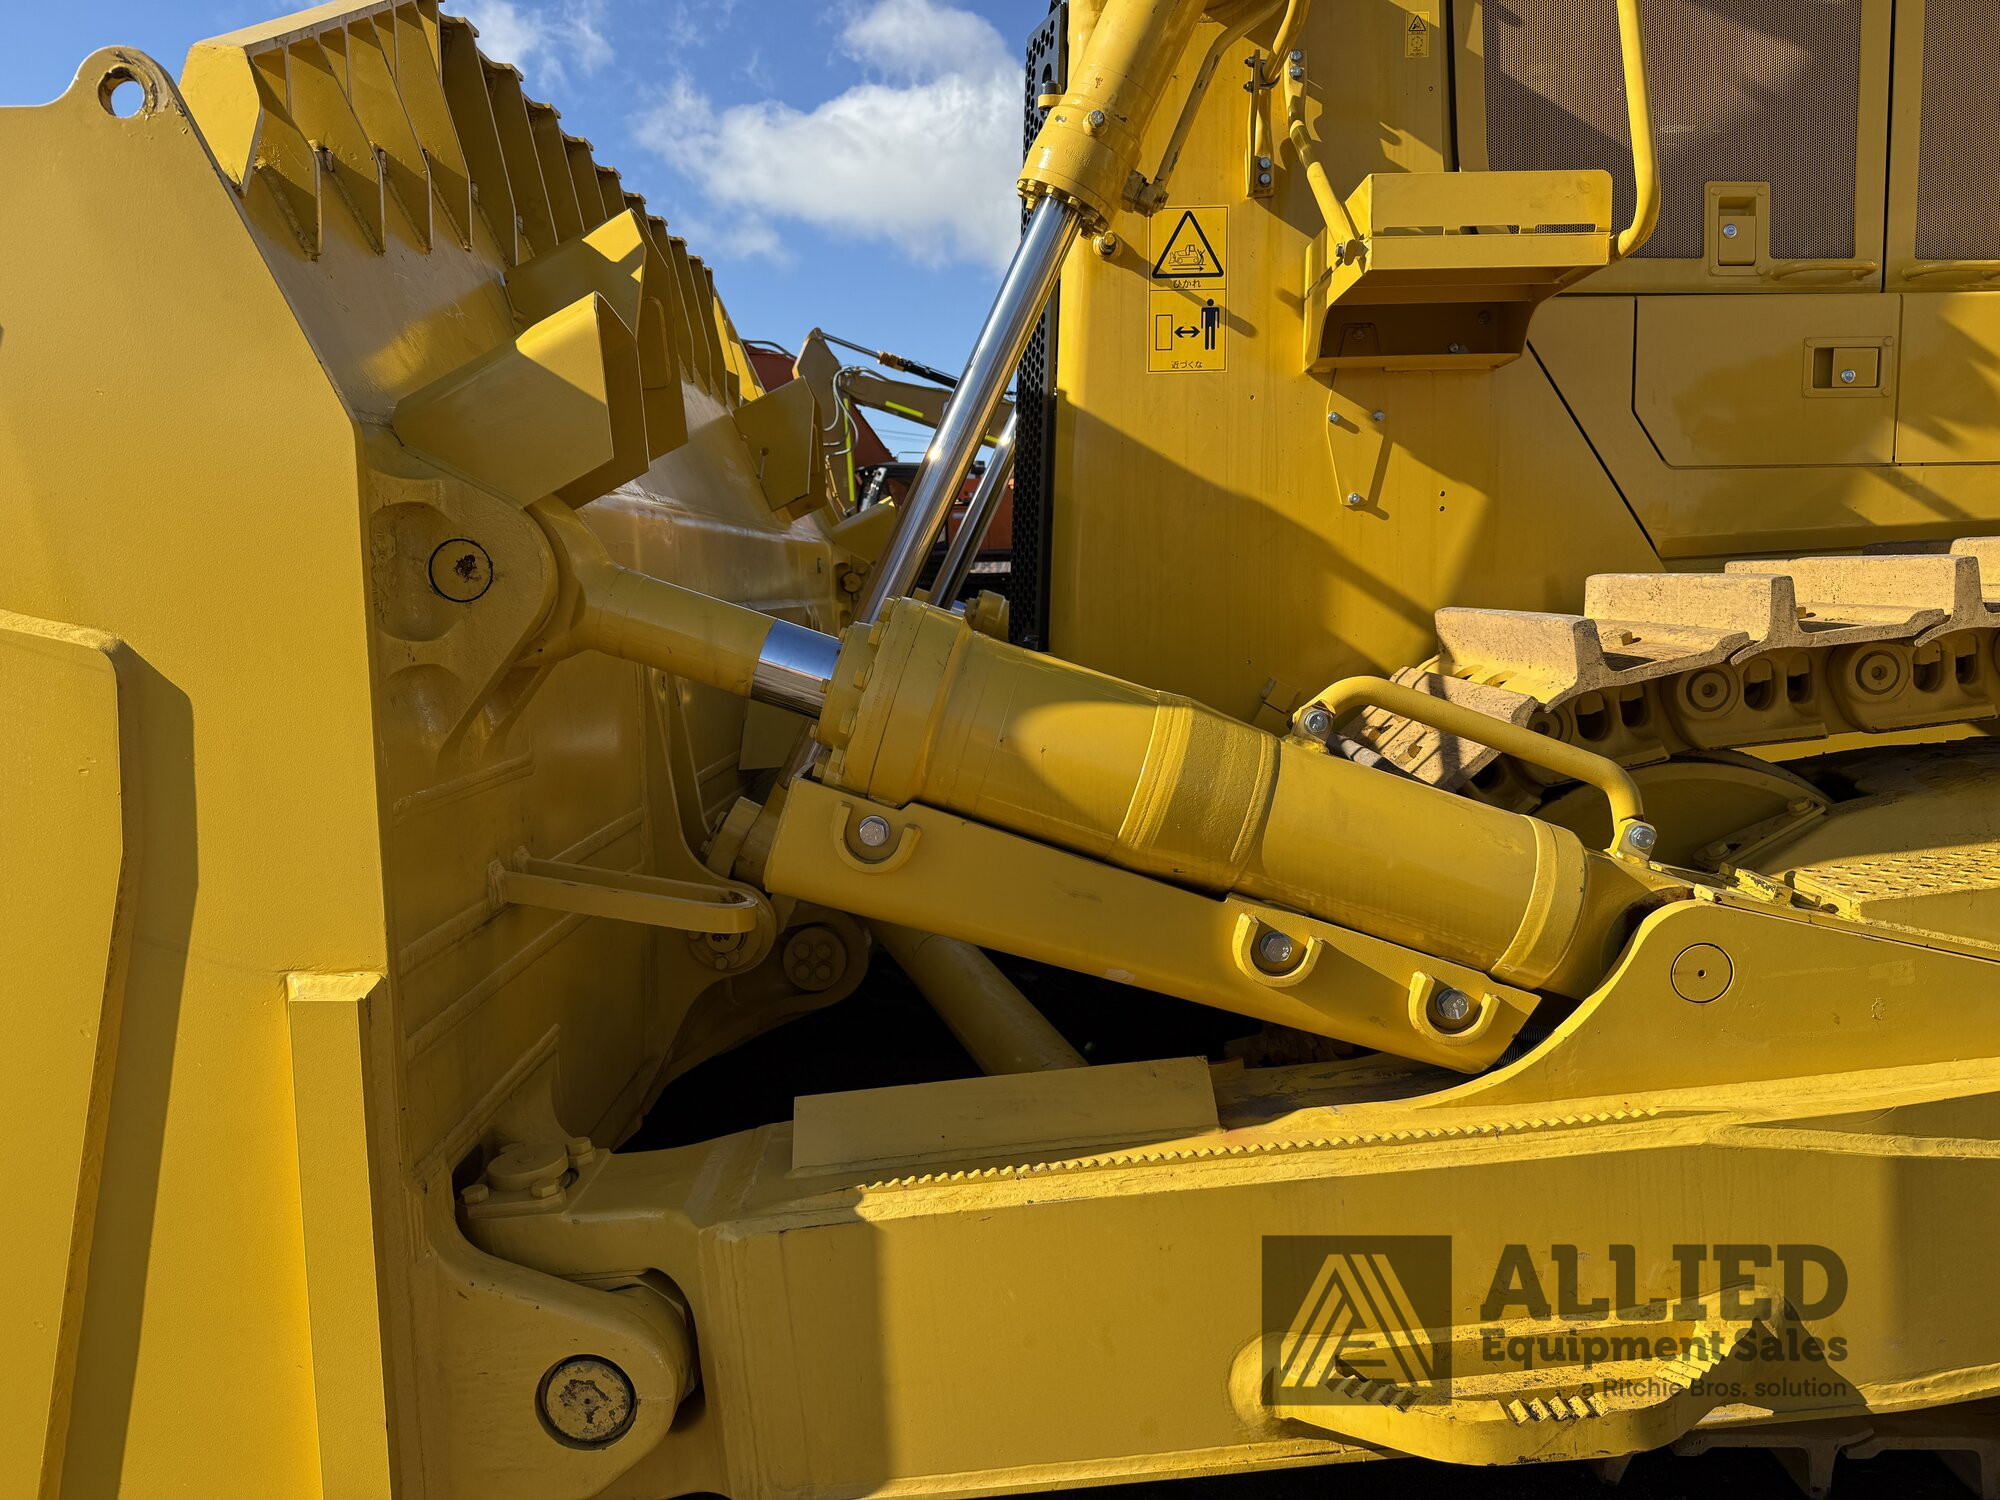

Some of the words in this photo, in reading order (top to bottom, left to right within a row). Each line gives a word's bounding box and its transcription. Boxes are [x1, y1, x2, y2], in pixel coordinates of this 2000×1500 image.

[1173, 279, 1201, 288] ひかれ
[1171, 360, 1203, 369] 近づくな
